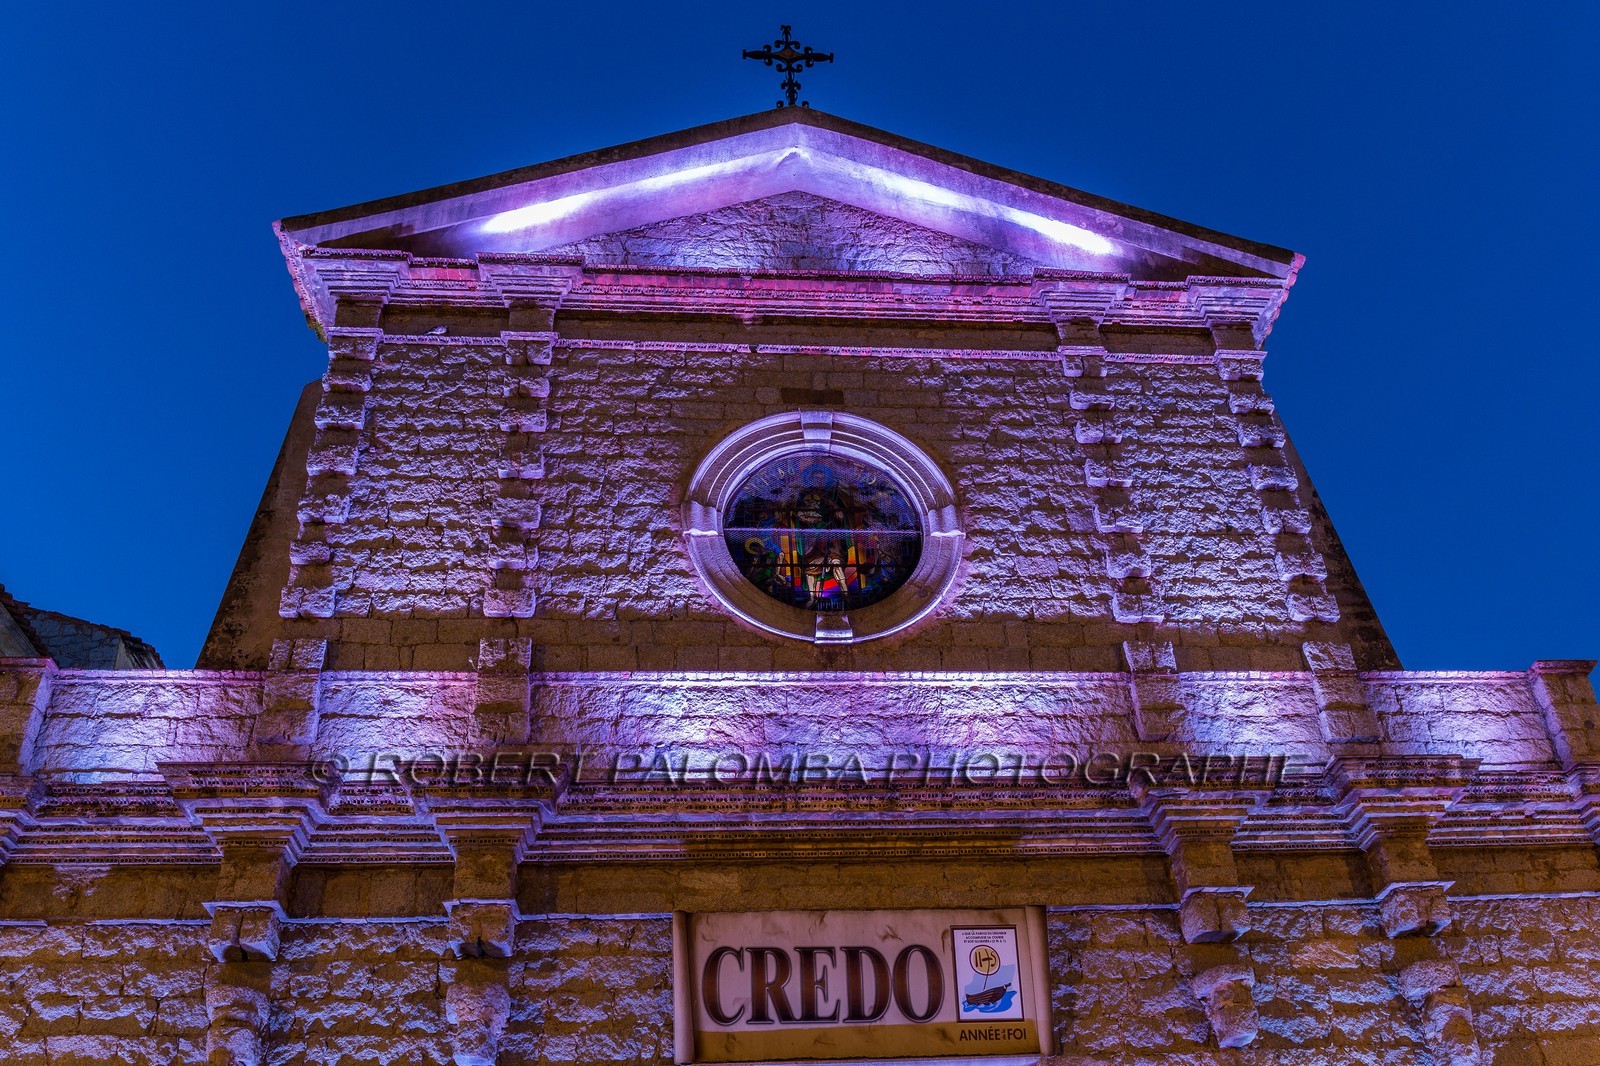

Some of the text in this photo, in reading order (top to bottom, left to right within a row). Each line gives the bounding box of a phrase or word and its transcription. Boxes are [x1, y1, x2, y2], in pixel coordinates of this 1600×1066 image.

[702, 944, 945, 1026] CREDO
[959, 1025, 1001, 1041] ANNÉE
[1007, 1028, 1027, 1040] FOI
